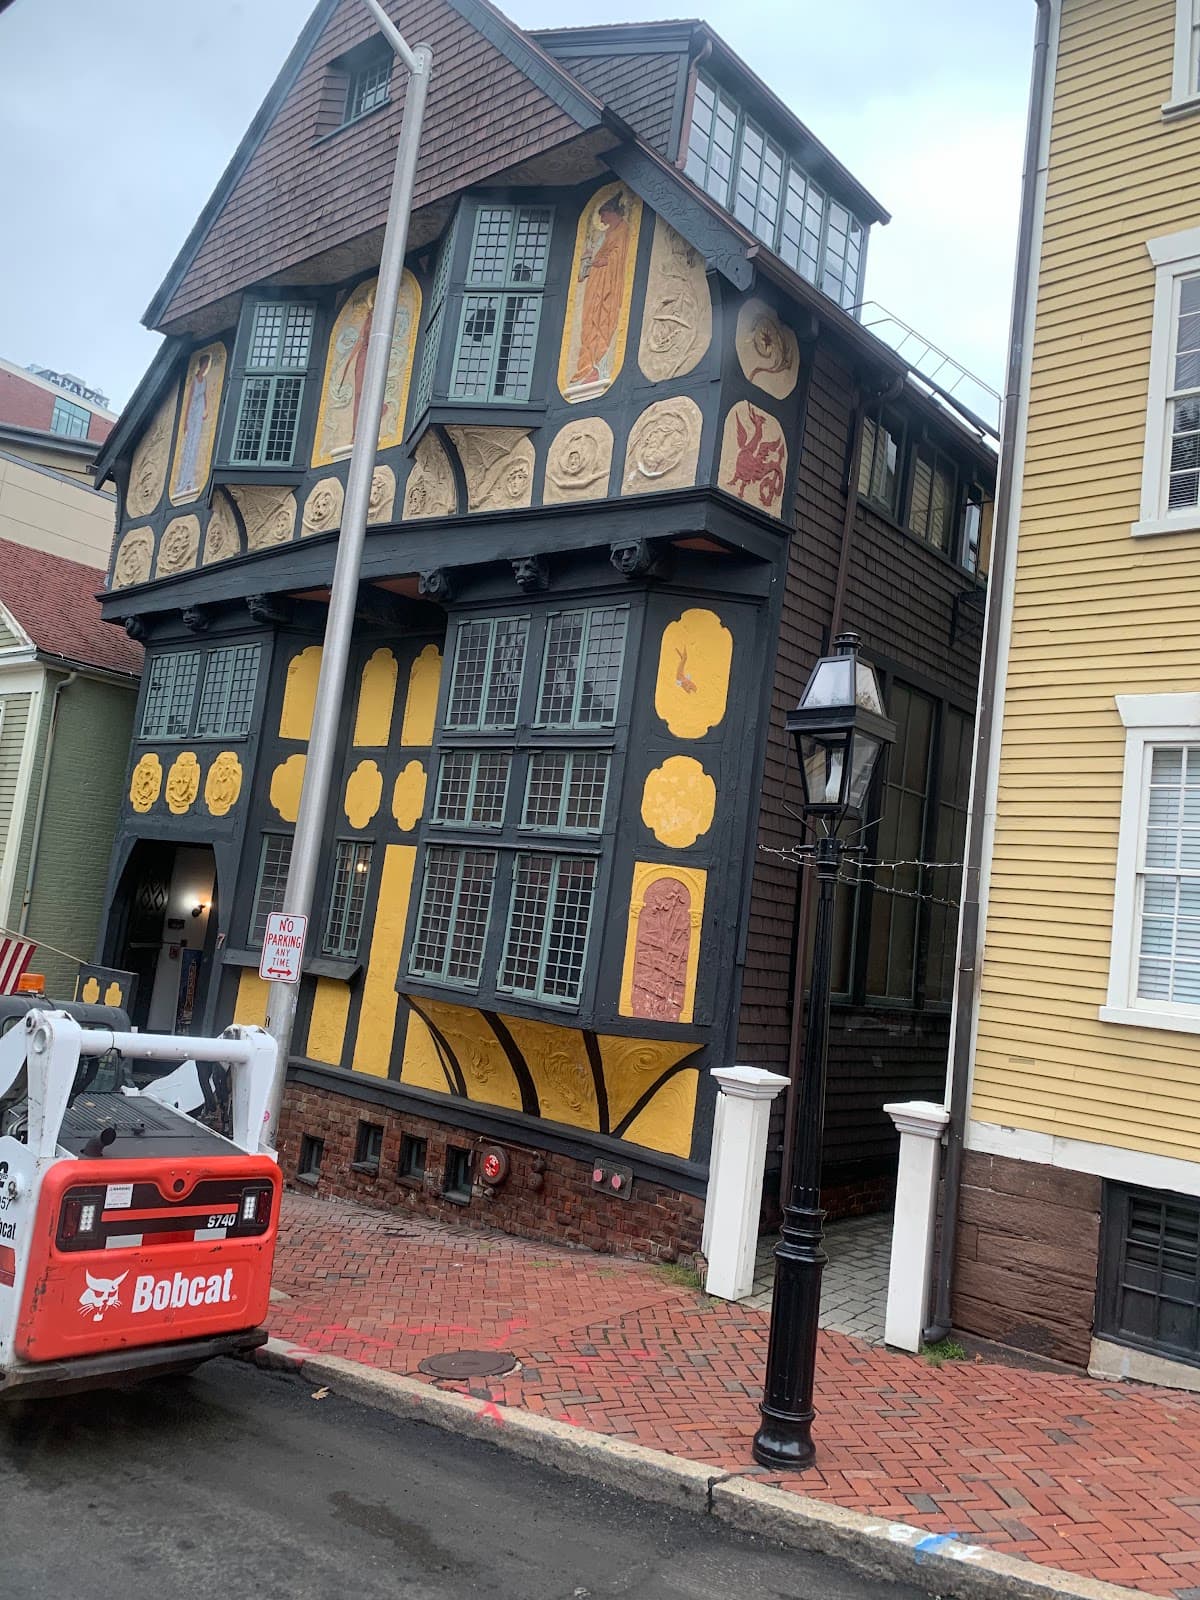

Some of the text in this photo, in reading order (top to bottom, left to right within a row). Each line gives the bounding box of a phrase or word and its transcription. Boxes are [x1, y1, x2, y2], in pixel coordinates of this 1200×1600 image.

[279, 920, 294, 933] NO
[267, 933, 302, 948] PARKING
[275, 948, 290, 958] ANY
[272, 957, 290, 967] TIME
[0, 1195, 11, 1211] 57
[207, 1214, 237, 1228] S740
[131, 1268, 234, 1313] Bobcat
